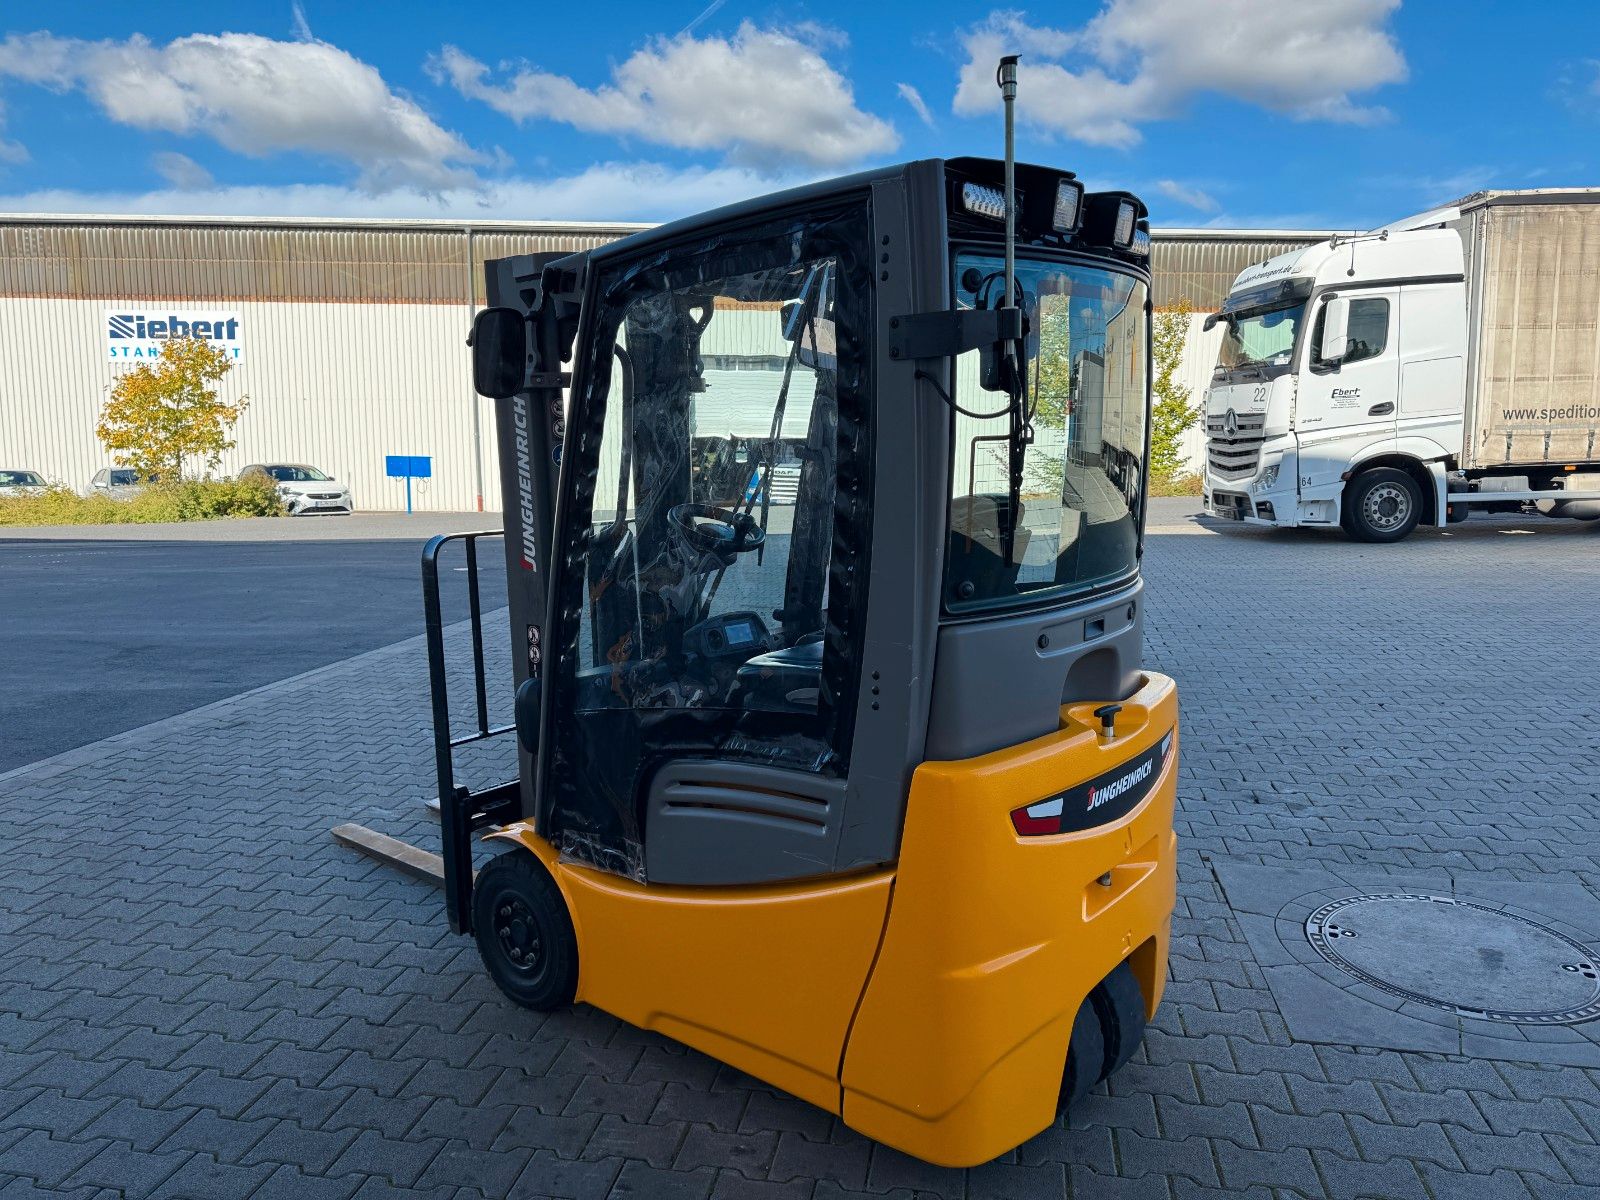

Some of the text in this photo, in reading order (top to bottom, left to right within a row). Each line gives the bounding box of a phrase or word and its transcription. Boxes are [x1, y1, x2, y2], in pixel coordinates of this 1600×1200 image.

[108, 315, 239, 339] Siebert
[1253, 387, 1266, 402] 22
[1331, 388, 1361, 399] Ebert
[512, 395, 537, 573] JUNGHEINRICH
[1301, 476, 1312, 487] 64
[1087, 757, 1153, 812] JUNGHEINRICH
